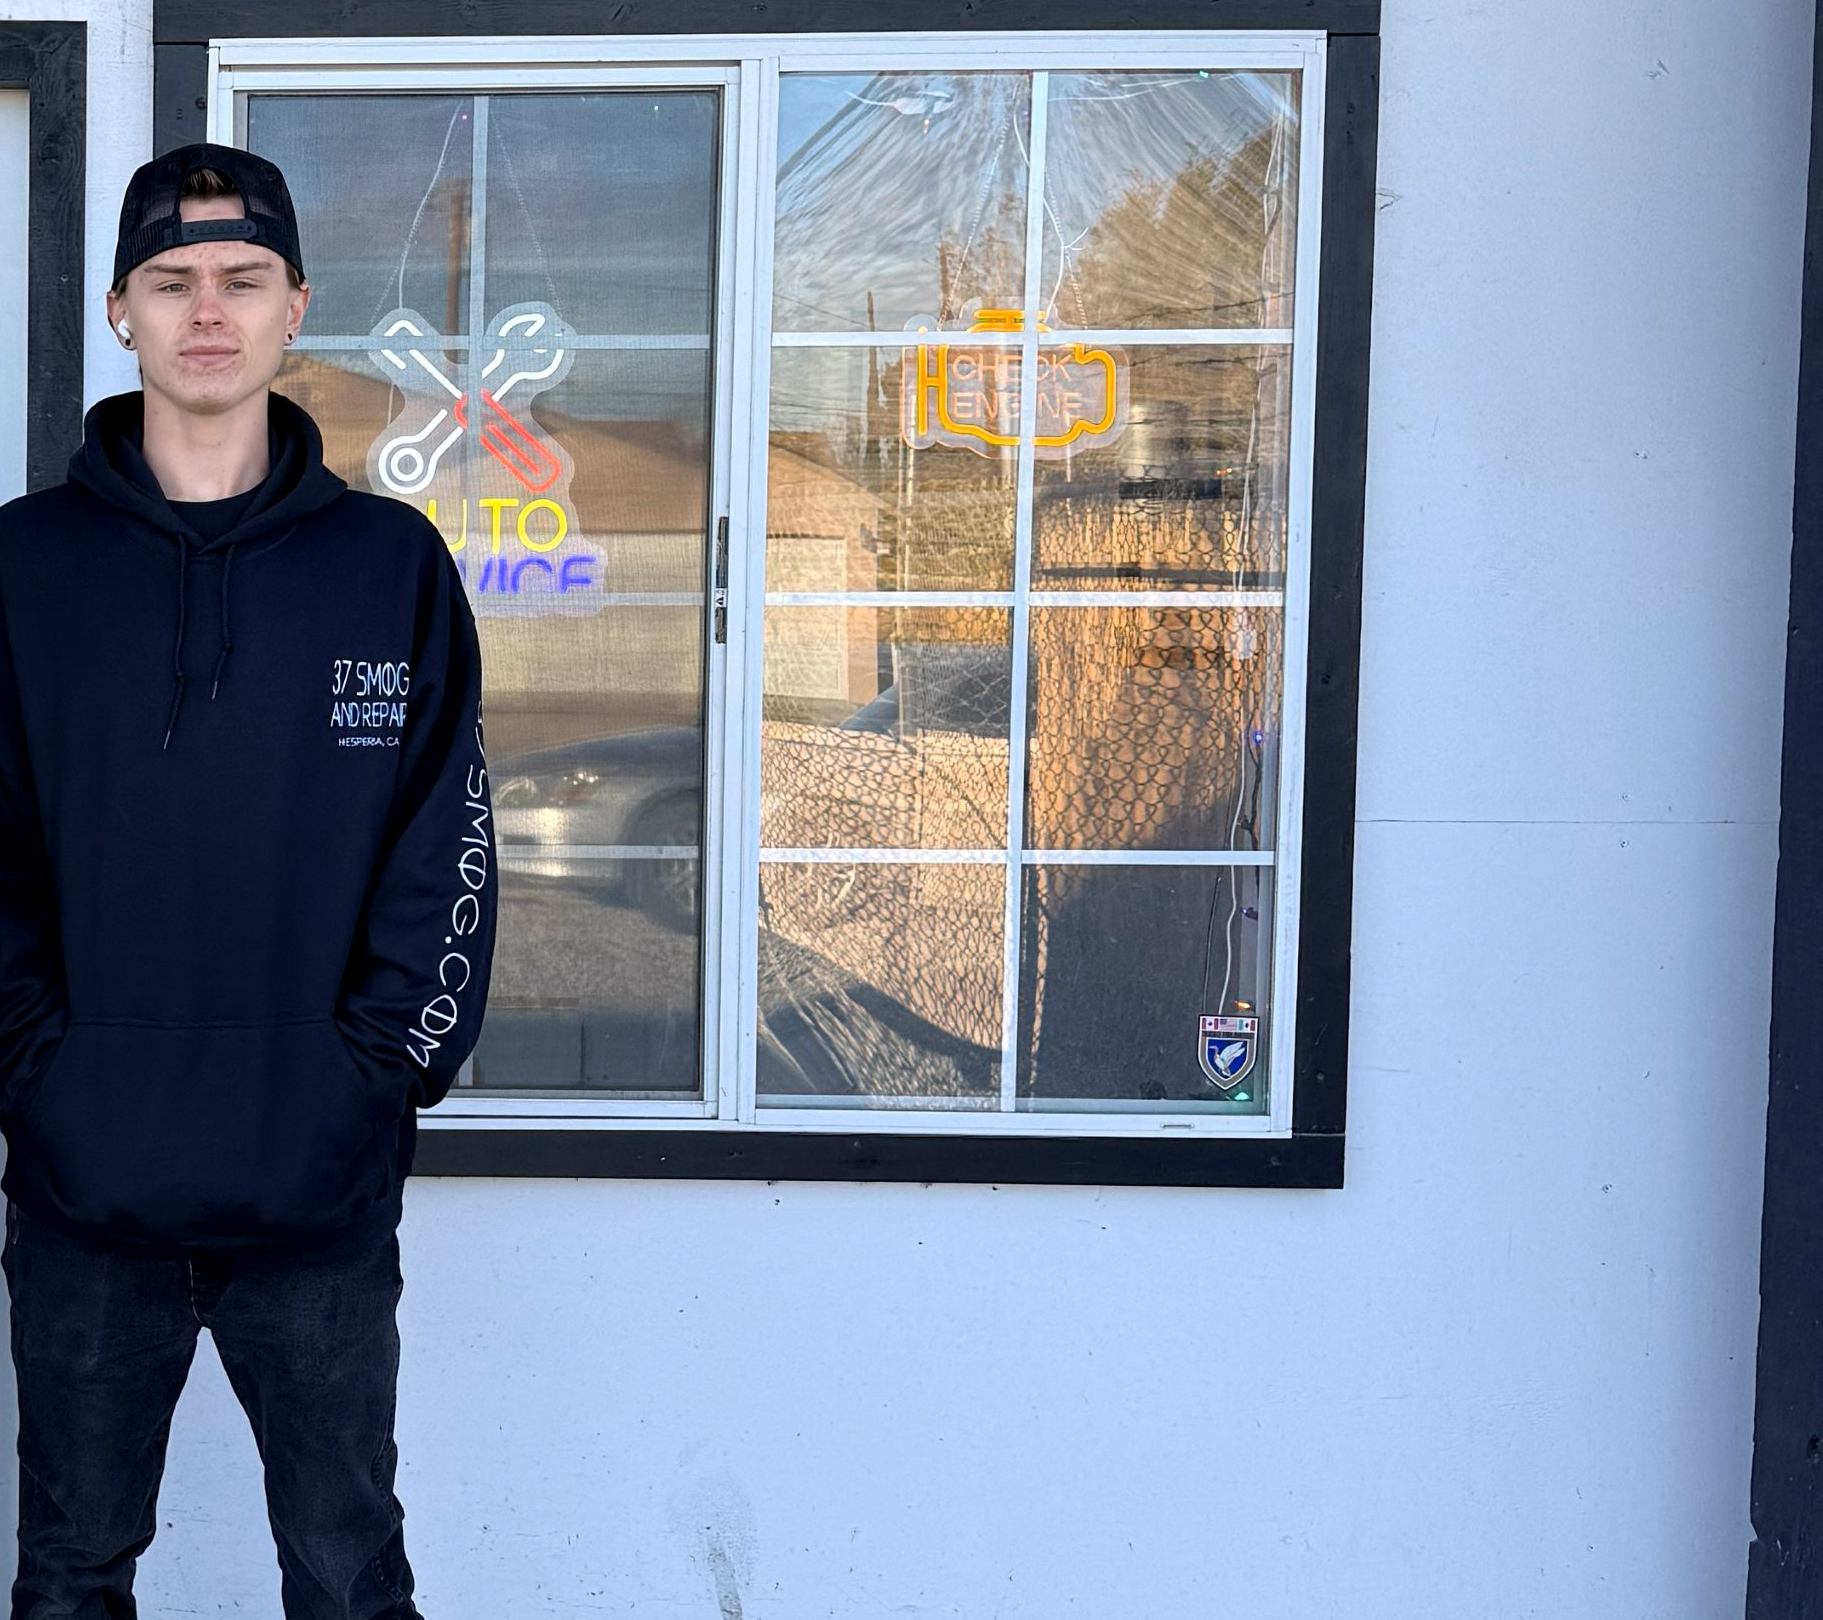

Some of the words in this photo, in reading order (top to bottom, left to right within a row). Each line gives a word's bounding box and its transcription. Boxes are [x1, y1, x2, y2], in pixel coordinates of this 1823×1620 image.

[951, 352, 1073, 383] CHECK
[951, 389, 1083, 419] ENGNE
[426, 497, 568, 555] UTO
[332, 659, 353, 695] 37
[356, 661, 410, 697] SMOG
[330, 701, 360, 728] AND
